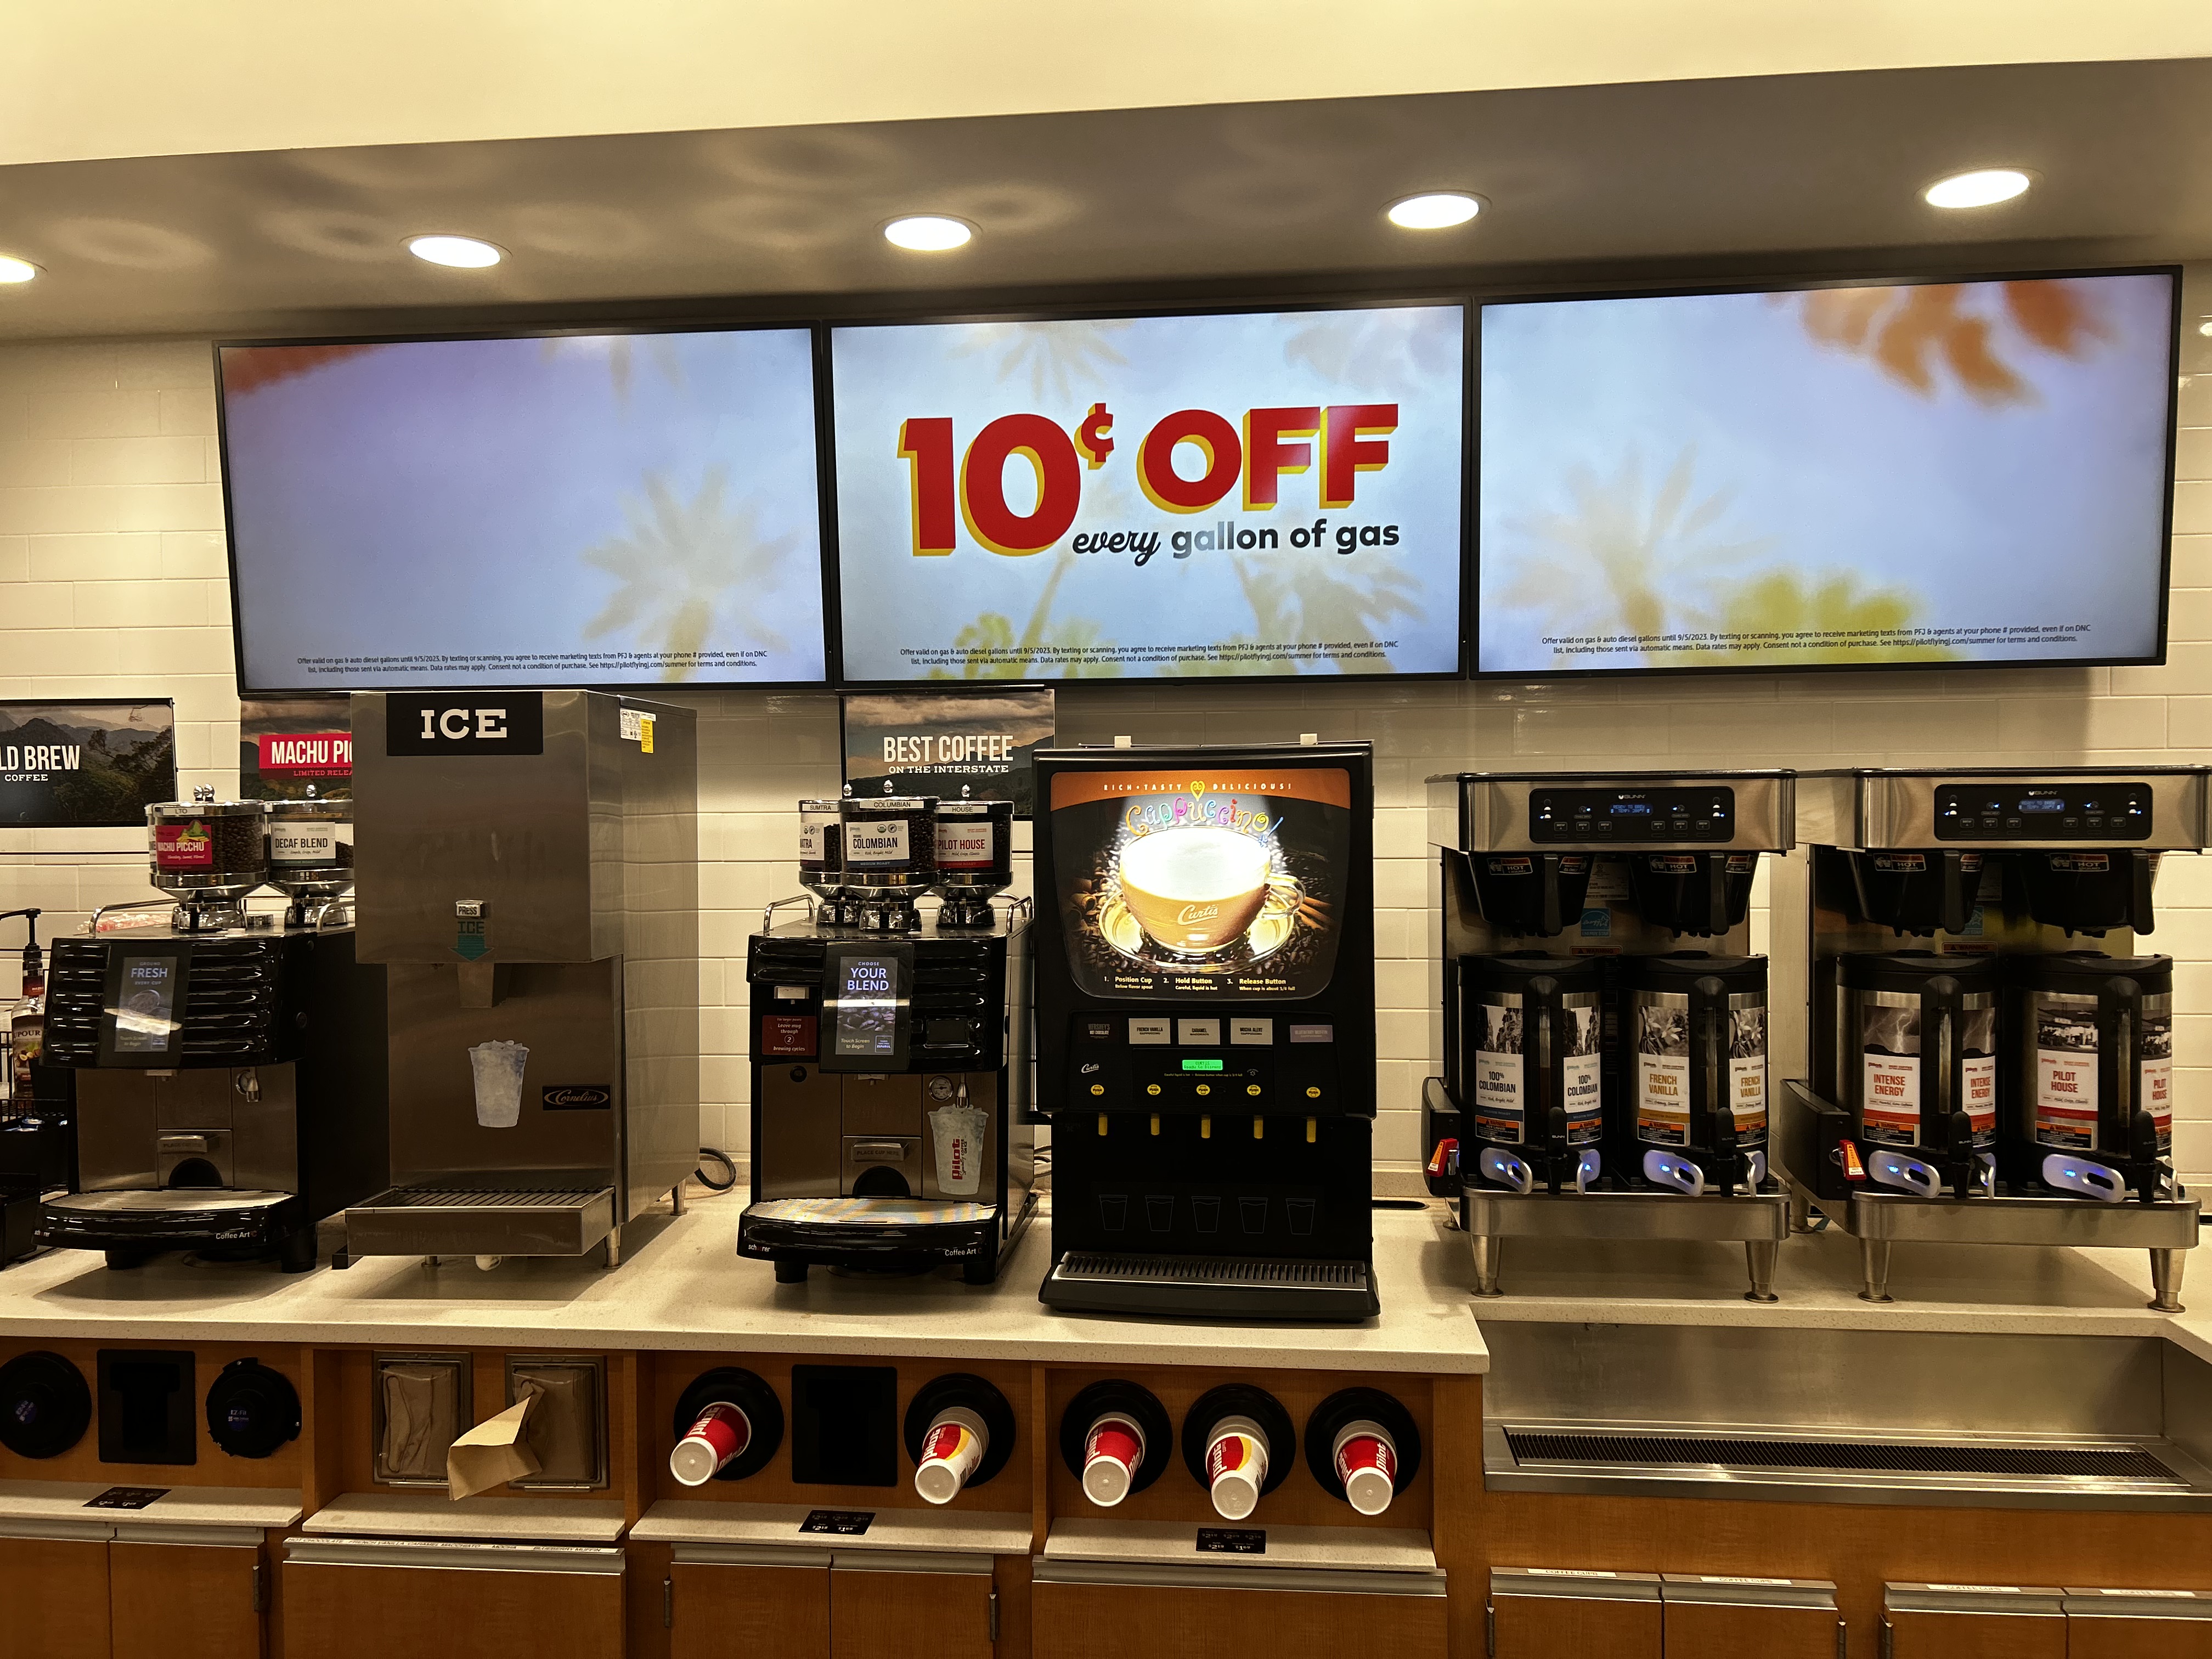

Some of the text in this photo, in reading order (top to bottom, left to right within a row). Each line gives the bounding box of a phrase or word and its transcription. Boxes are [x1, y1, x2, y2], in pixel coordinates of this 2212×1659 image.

[1136, 403, 1398, 515] OFF
[1072, 518, 1400, 566] every gallon of gas
[988, 646, 1008, 655] gallons
[1052, 645, 1060, 654] By
[1061, 645, 1081, 654] texting
[1177, 644, 1206, 652] marketing
[1255, 642, 1274, 651] agents
[1297, 642, 1317, 651] phone
[922, 657, 949, 665] including
[421, 709, 507, 740] ICE
[272, 741, 328, 764] MACHU
[883, 735, 1013, 763] BEST COFFEE
[24, 745, 80, 770] BREW
[934, 765, 1009, 774] INTERSTATE
[177, 842, 205, 851] PICCHU
[275, 838, 328, 848] DECAF BLEND
[853, 837, 898, 849] COLOMBIAN
[938, 839, 985, 850] PILOT HOUSE
[458, 905, 477, 915] PRESS
[1177, 904, 1218, 926] Curtis
[457, 921, 484, 934] ICE
[131, 968, 168, 978] FRESH
[851, 968, 887, 978] YOUR
[847, 980, 889, 990] BLEND
[1488, 1071, 1504, 1081] 100%
[1650, 1074, 1677, 1085] FRENCH
[1741, 1075, 1760, 1087] FRENCH
[1874, 1074, 1905, 1086] INTENSE
[2053, 1070, 2076, 1081] PILOT
[1479, 1080, 1516, 1093] COLOMBIAN
[1970, 1076, 1991, 1088] INTENSE
[2051, 1081, 2078, 1093] HOUSE
[2153, 1078, 2166, 1089] PILOT
[1567, 1083, 1598, 1097] COLOMBIAN
[1649, 1084, 1678, 1096] VANILLA
[1740, 1086, 1761, 1097] VANILLA
[1875, 1085, 1905, 1097] ENERGY
[1971, 1087, 1990, 1099] ENERGY
[555, 1090, 598, 1105] Cornelius
[952, 1138, 962, 1180] pilot
[922, 1428, 941, 1463] pilot
[1213, 1443, 1227, 1479] pilot
[1376, 1442, 1390, 1476] pilot
